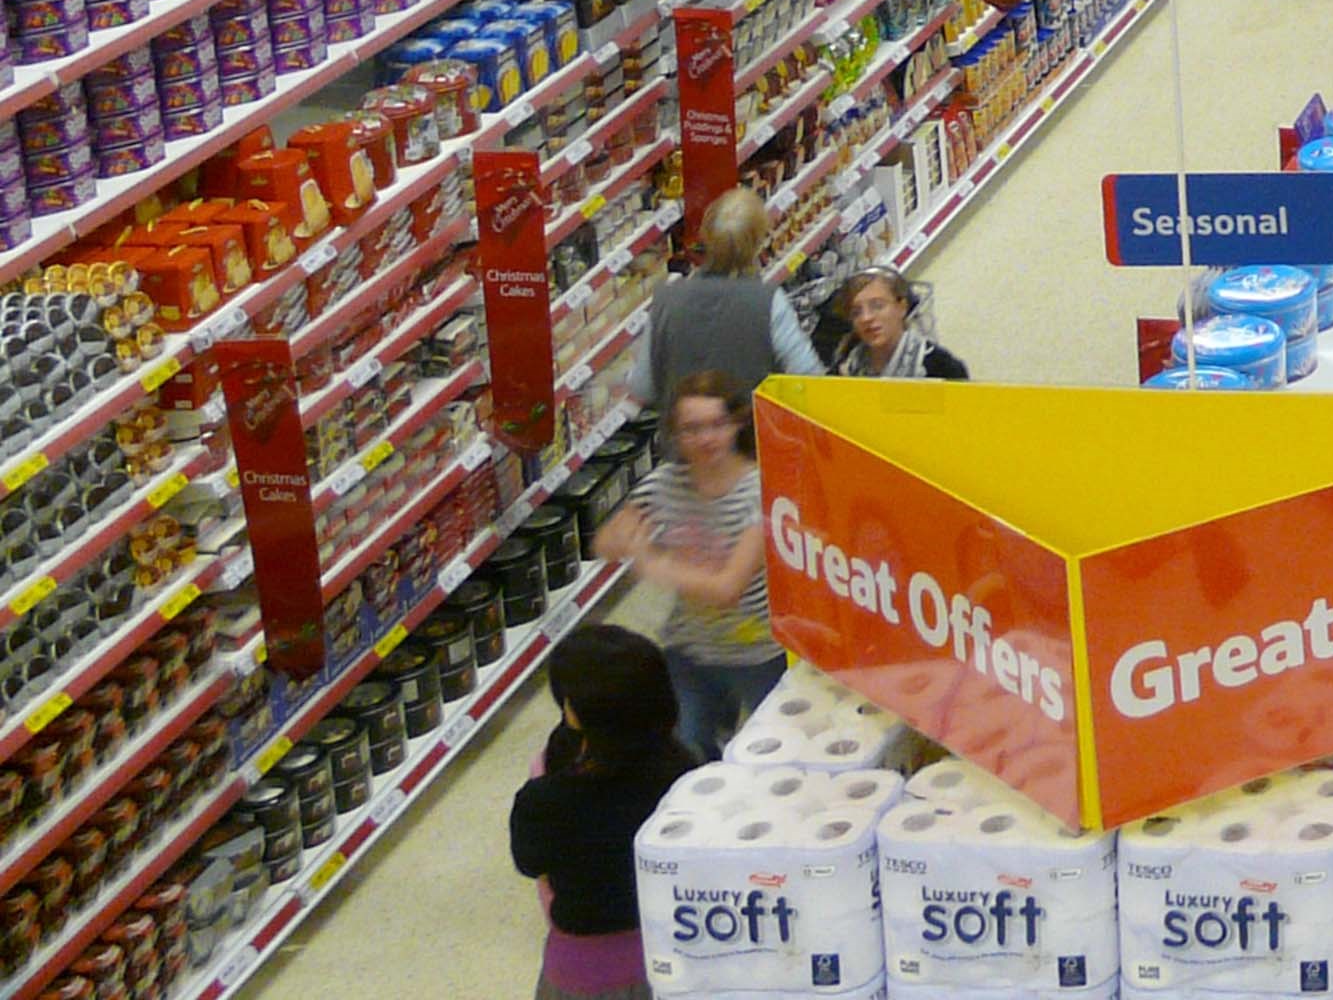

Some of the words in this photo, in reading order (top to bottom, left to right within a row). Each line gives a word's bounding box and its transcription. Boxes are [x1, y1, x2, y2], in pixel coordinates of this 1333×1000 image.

[1132, 206, 1288, 236] Seasonal
[486, 268, 545, 282] Christmas
[500, 284, 535, 298] Cakes
[243, 471, 307, 485] Christmas
[259, 486, 297, 502] Cakes
[769, 494, 897, 627] Great
[908, 570, 1065, 722] Offers
[885, 858, 928, 873] TESCO
[1128, 863, 1173, 877] TESCO
[673, 885, 742, 907] Luxury
[922, 885, 990, 907] Luxury
[1164, 890, 1232, 913] Luxury
[673, 890, 793, 944] soft
[922, 890, 1043, 947] soft
[1163, 896, 1286, 951] soft
